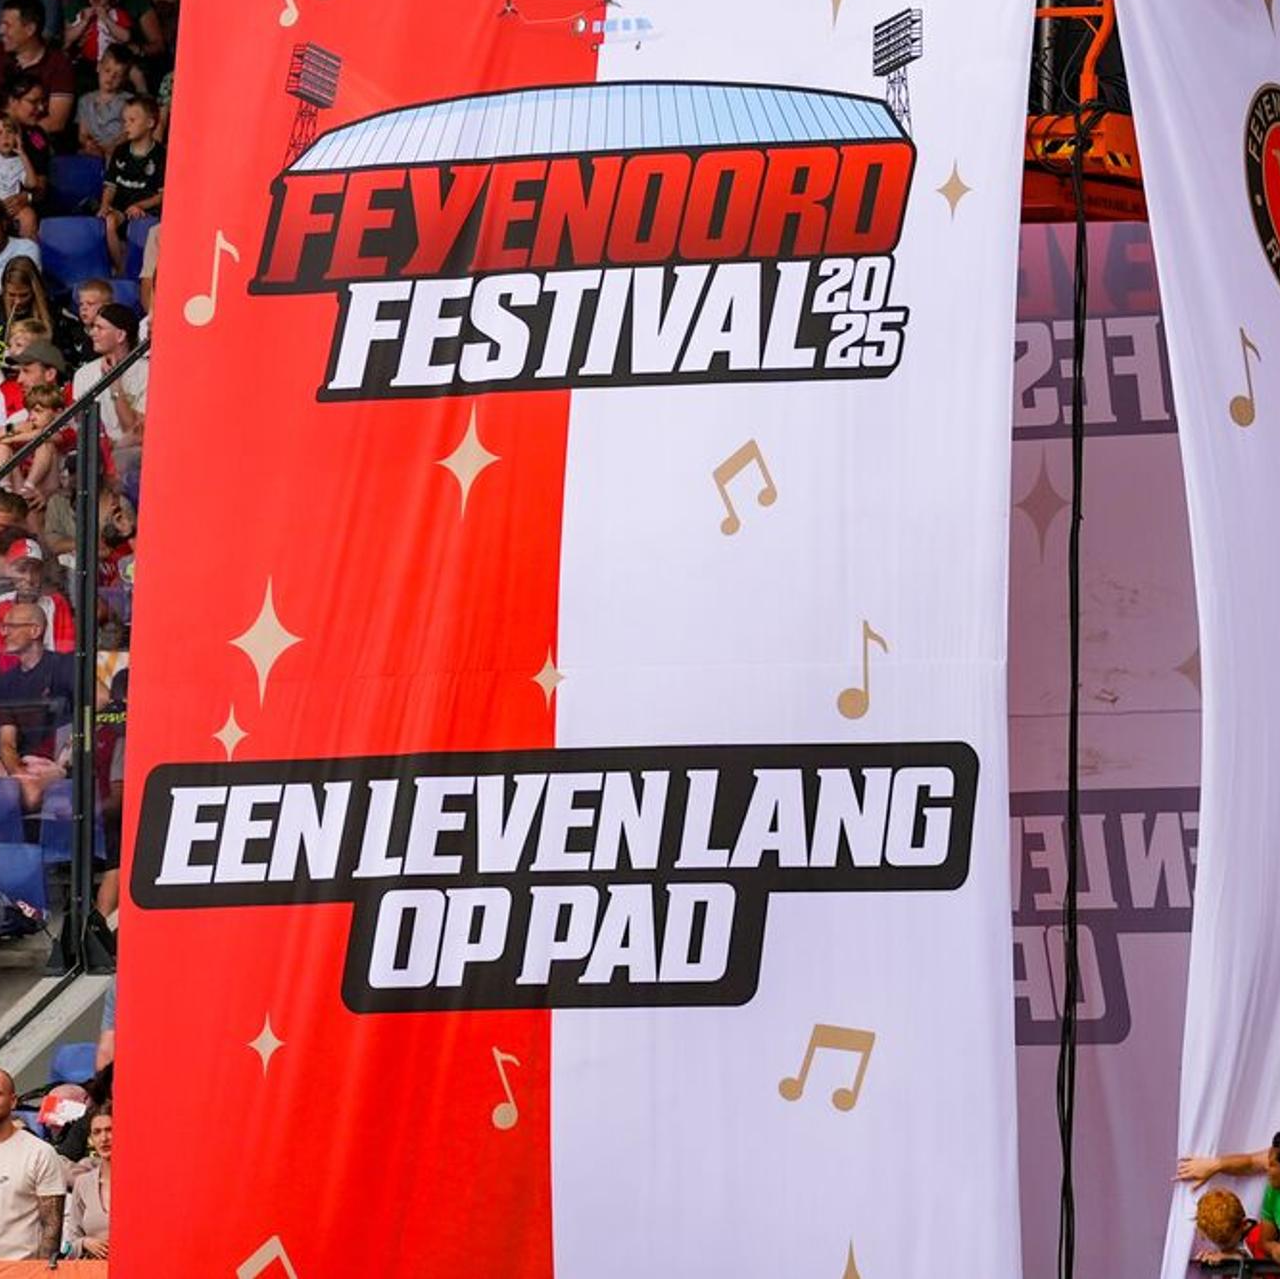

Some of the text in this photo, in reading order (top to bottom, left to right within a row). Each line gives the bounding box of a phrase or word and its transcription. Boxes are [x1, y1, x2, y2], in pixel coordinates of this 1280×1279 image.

[262, 143, 912, 284] FEYENOORD
[328, 261, 817, 390] FESTIVAL
[812, 257, 890, 313] 20
[825, 312, 904, 369] 25
[155, 767, 954, 885] EEN LEVEN LANG
[368, 882, 736, 989] OP PAD
